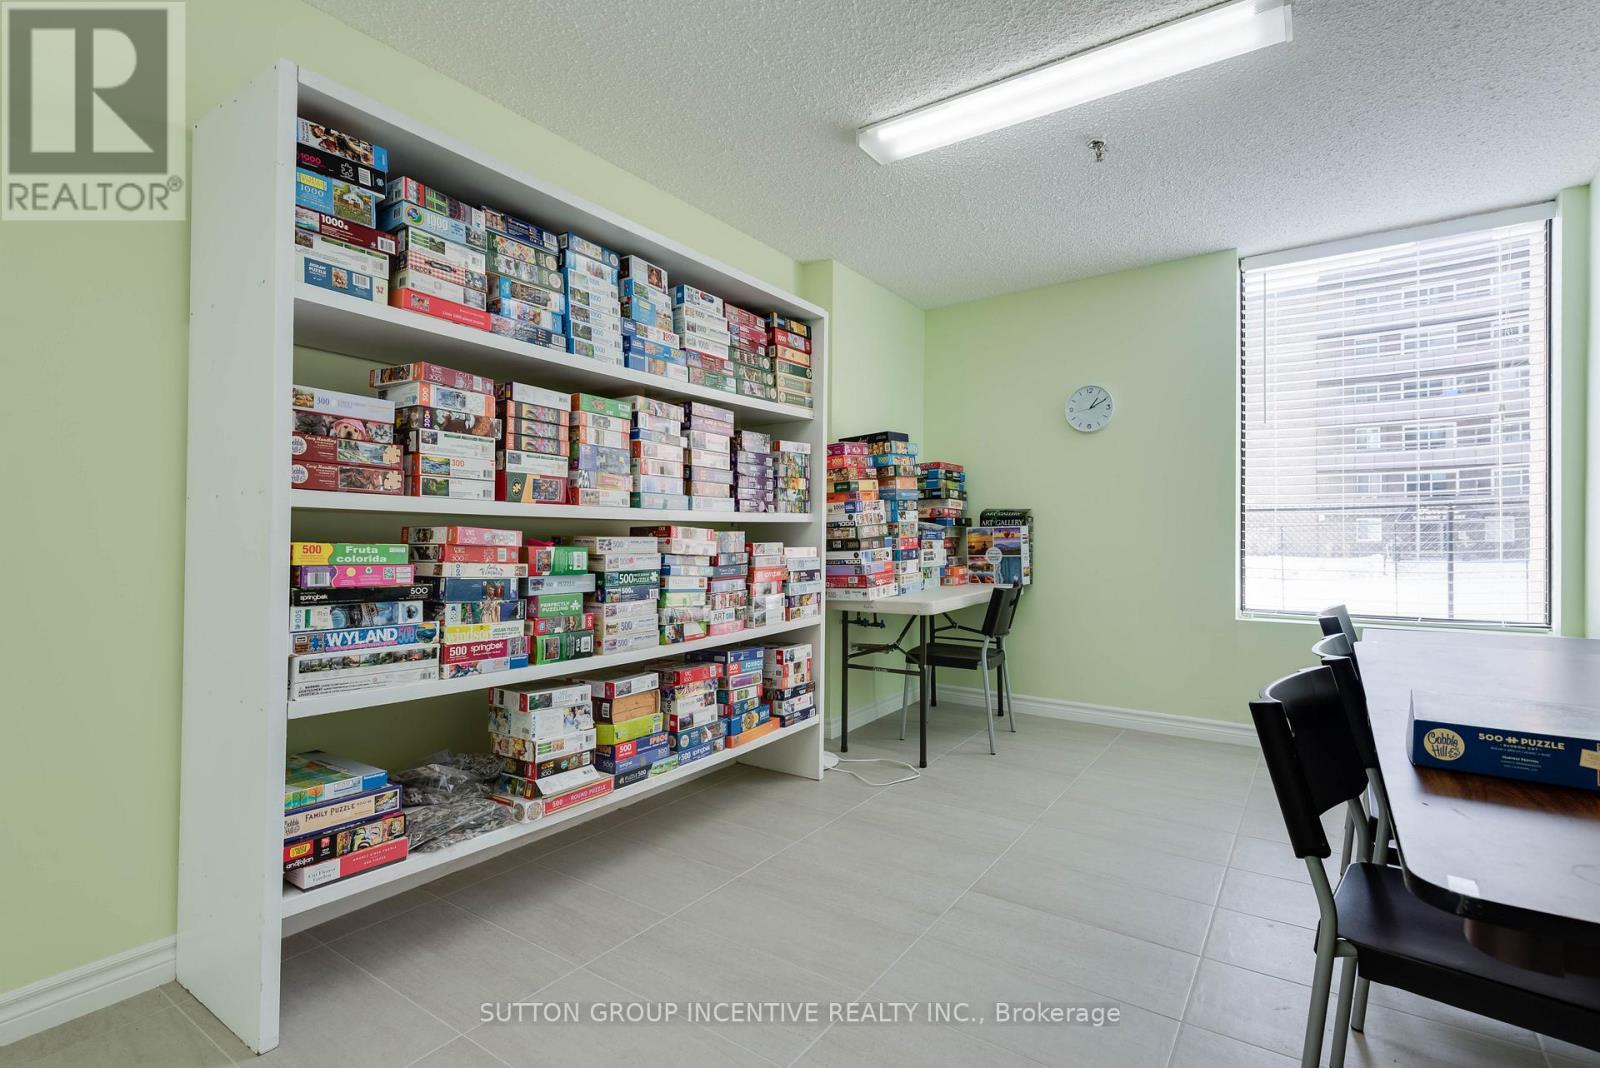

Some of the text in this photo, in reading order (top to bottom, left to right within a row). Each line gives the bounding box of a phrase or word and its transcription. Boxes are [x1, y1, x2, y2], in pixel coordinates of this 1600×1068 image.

[301, 152, 322, 165] 1000
[300, 183, 324, 197] 1000
[321, 214, 344, 229] 1000
[451, 459, 465, 468] 300
[981, 519, 1024, 527] ART GALLERY
[302, 545, 322, 554] 500
[345, 545, 379, 554] Fruta
[336, 555, 387, 563] colorida
[619, 573, 634, 584] 500
[410, 587, 429, 595] 500
[713, 612, 726, 622] ART
[620, 621, 633, 631] 500
[325, 627, 398, 646] WYLAND
[449, 645, 468, 657] 500
[1427, 731, 1458, 747] Cobble
[1478, 733, 1566, 750] 500 PUZZLE
[619, 743, 632, 752] 500
[1432, 744, 1448, 757] Hill
[681, 751, 692, 761] 500
[570, 791, 588, 801] ROUND
[588, 785, 606, 795] PUZZLE
[305, 803, 356, 823] FAMILY PUZZLE
